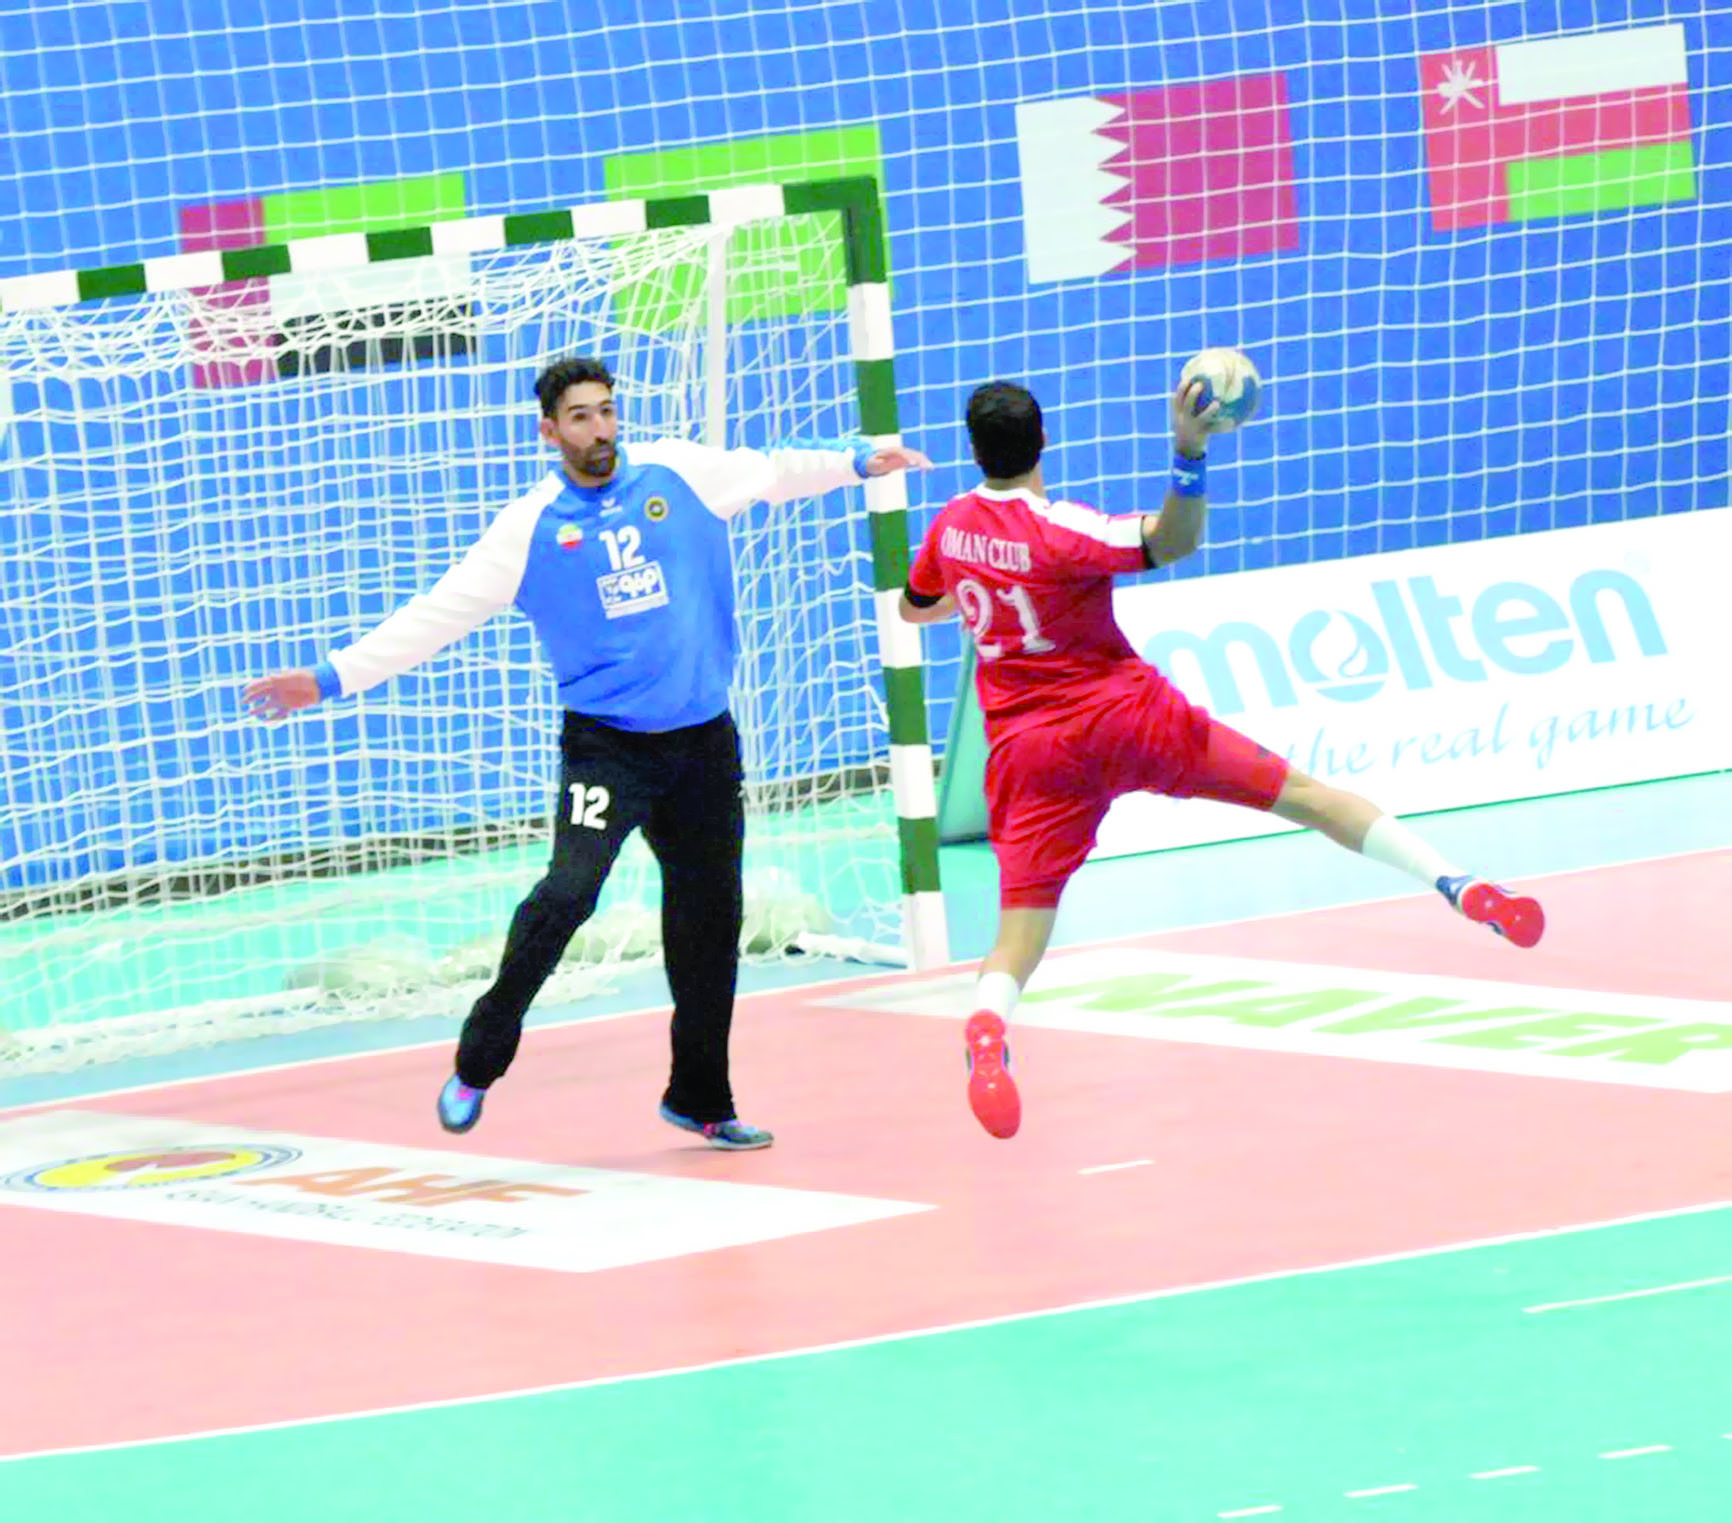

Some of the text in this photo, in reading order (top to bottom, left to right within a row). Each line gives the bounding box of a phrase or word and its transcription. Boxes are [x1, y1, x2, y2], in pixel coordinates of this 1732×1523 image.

[598, 525, 646, 571] 12
[941, 526, 1032, 573] OMAN CLUB
[956, 579, 1056, 659] 21
[1143, 568, 1669, 717] molten
[1391, 703, 1511, 768] real
[1527, 697, 1696, 770] game
[568, 782, 610, 830] 12
[230, 1166, 593, 1207] AHF
